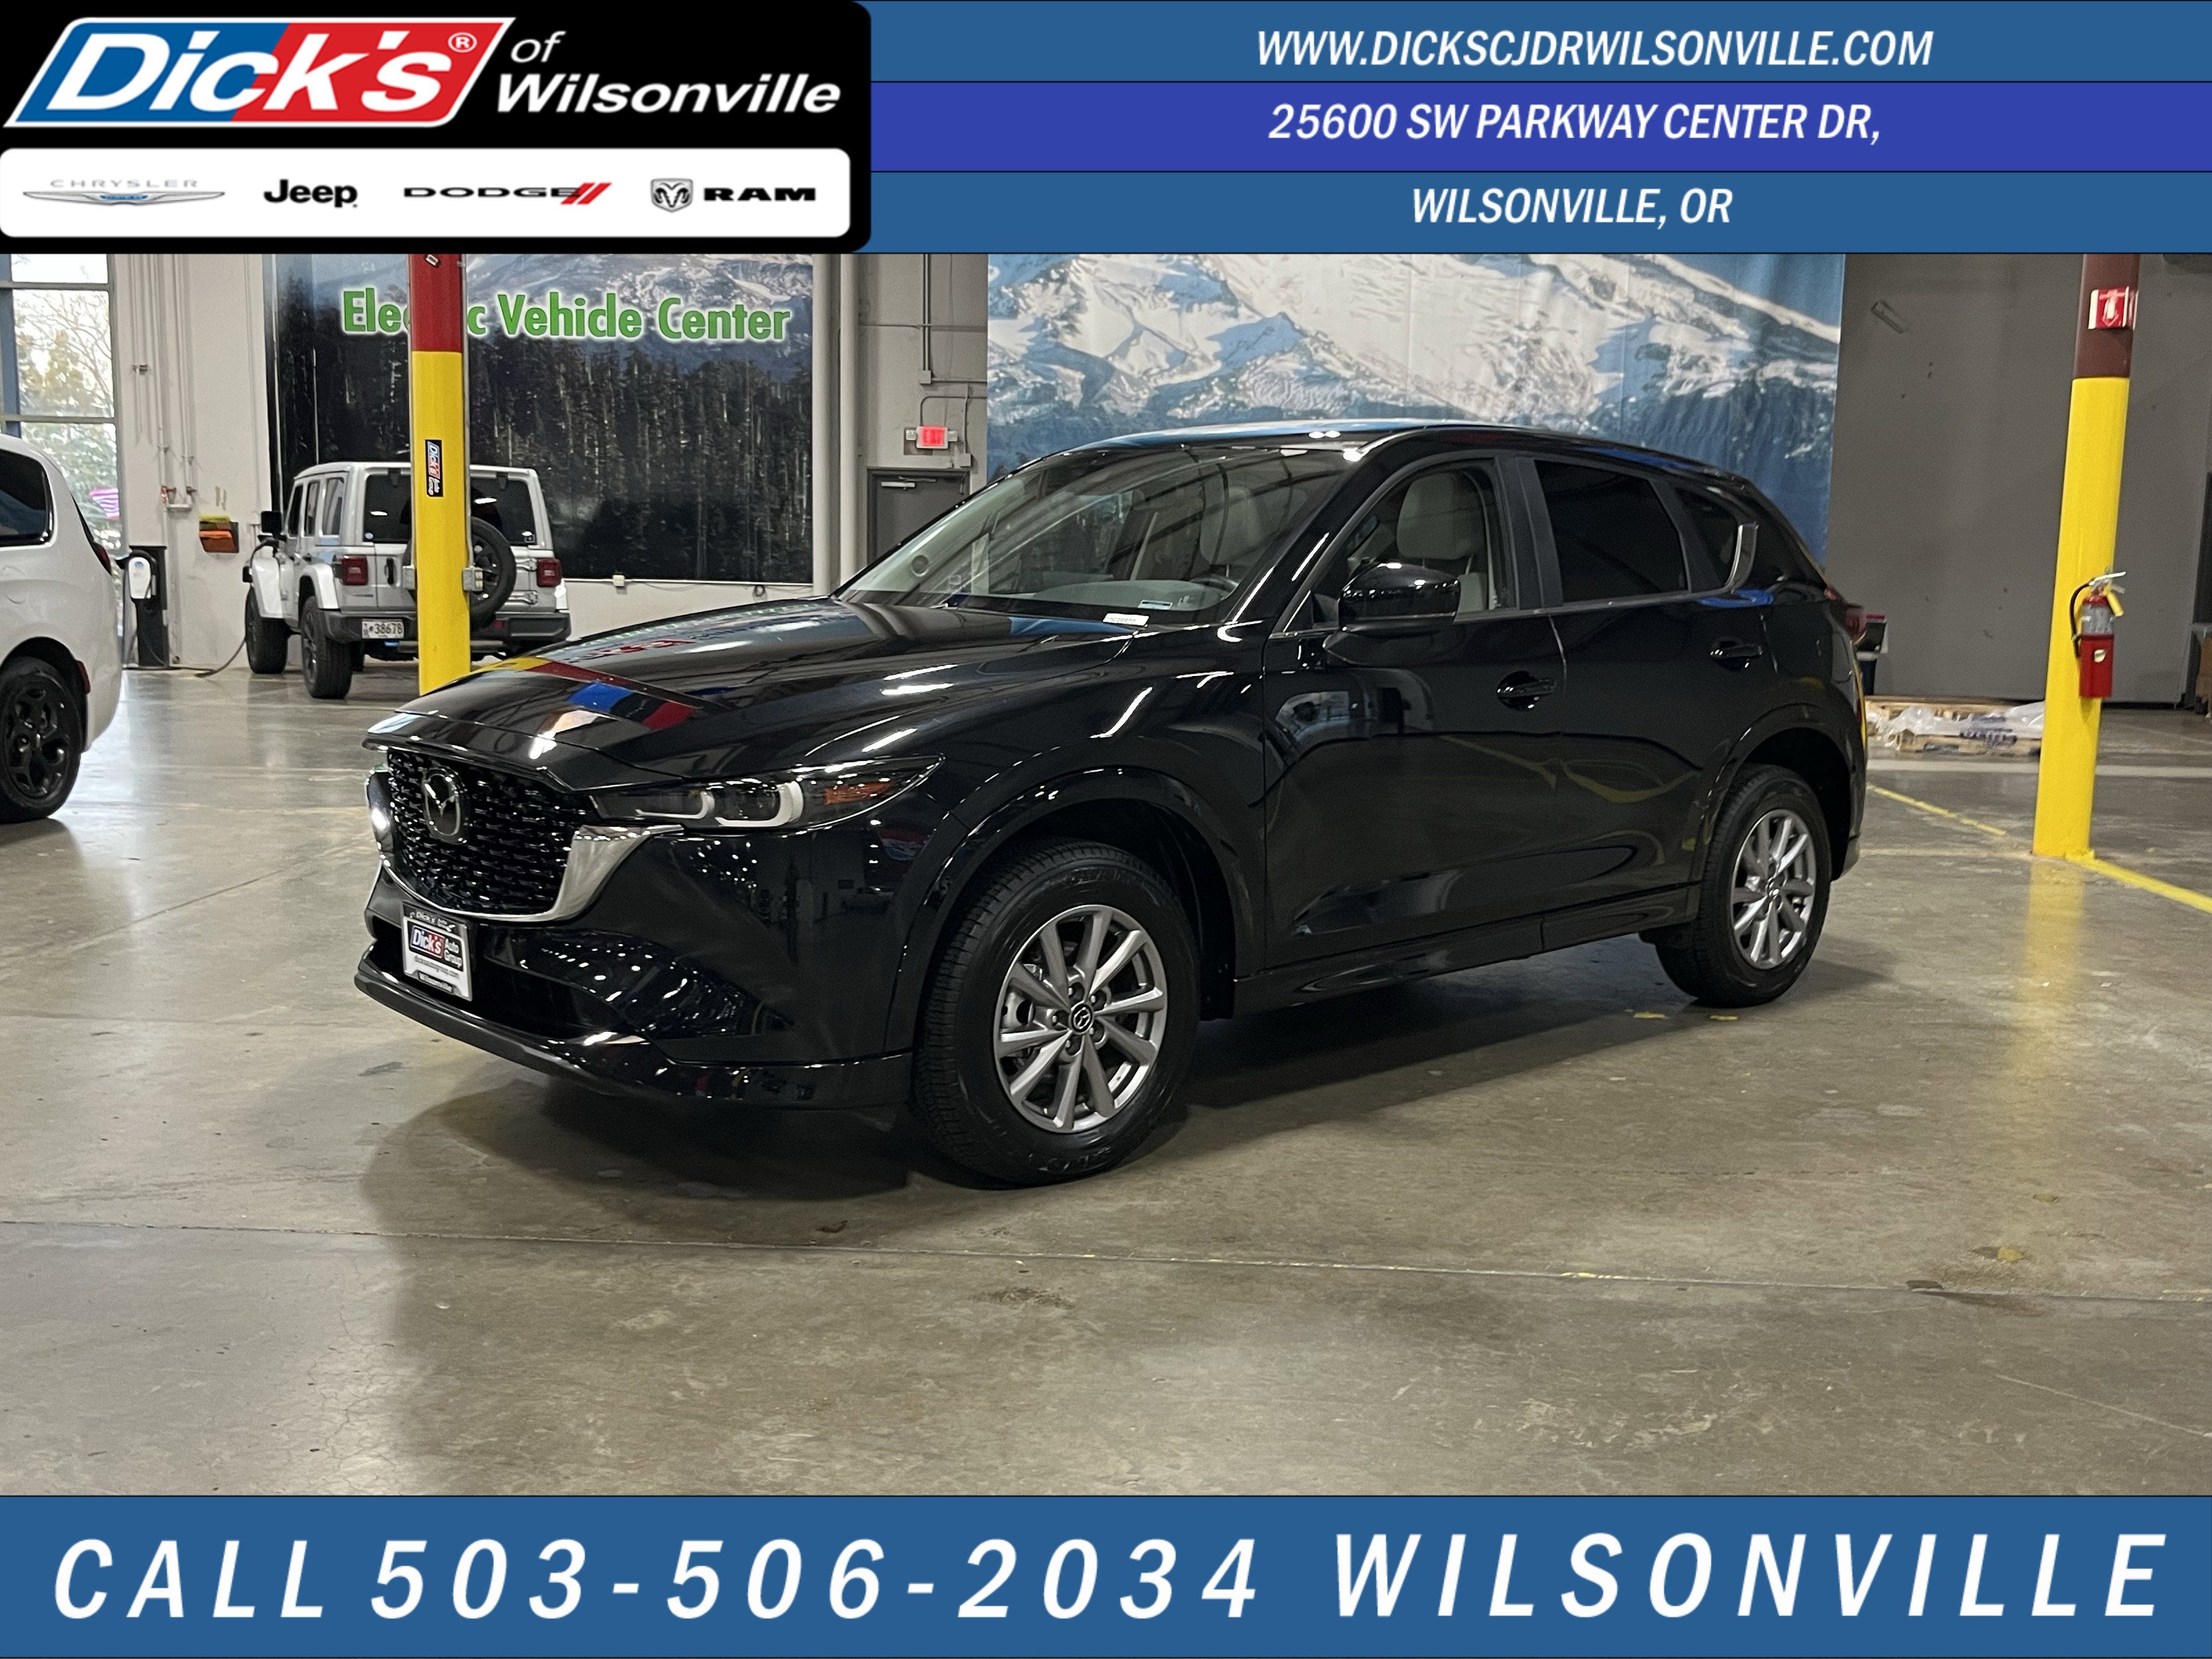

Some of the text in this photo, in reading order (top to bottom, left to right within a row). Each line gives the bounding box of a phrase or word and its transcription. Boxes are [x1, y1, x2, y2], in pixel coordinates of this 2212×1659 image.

[497, 292, 642, 338] Vehicle
[658, 297, 792, 340] Center
[413, 928, 442, 955] Dick's
